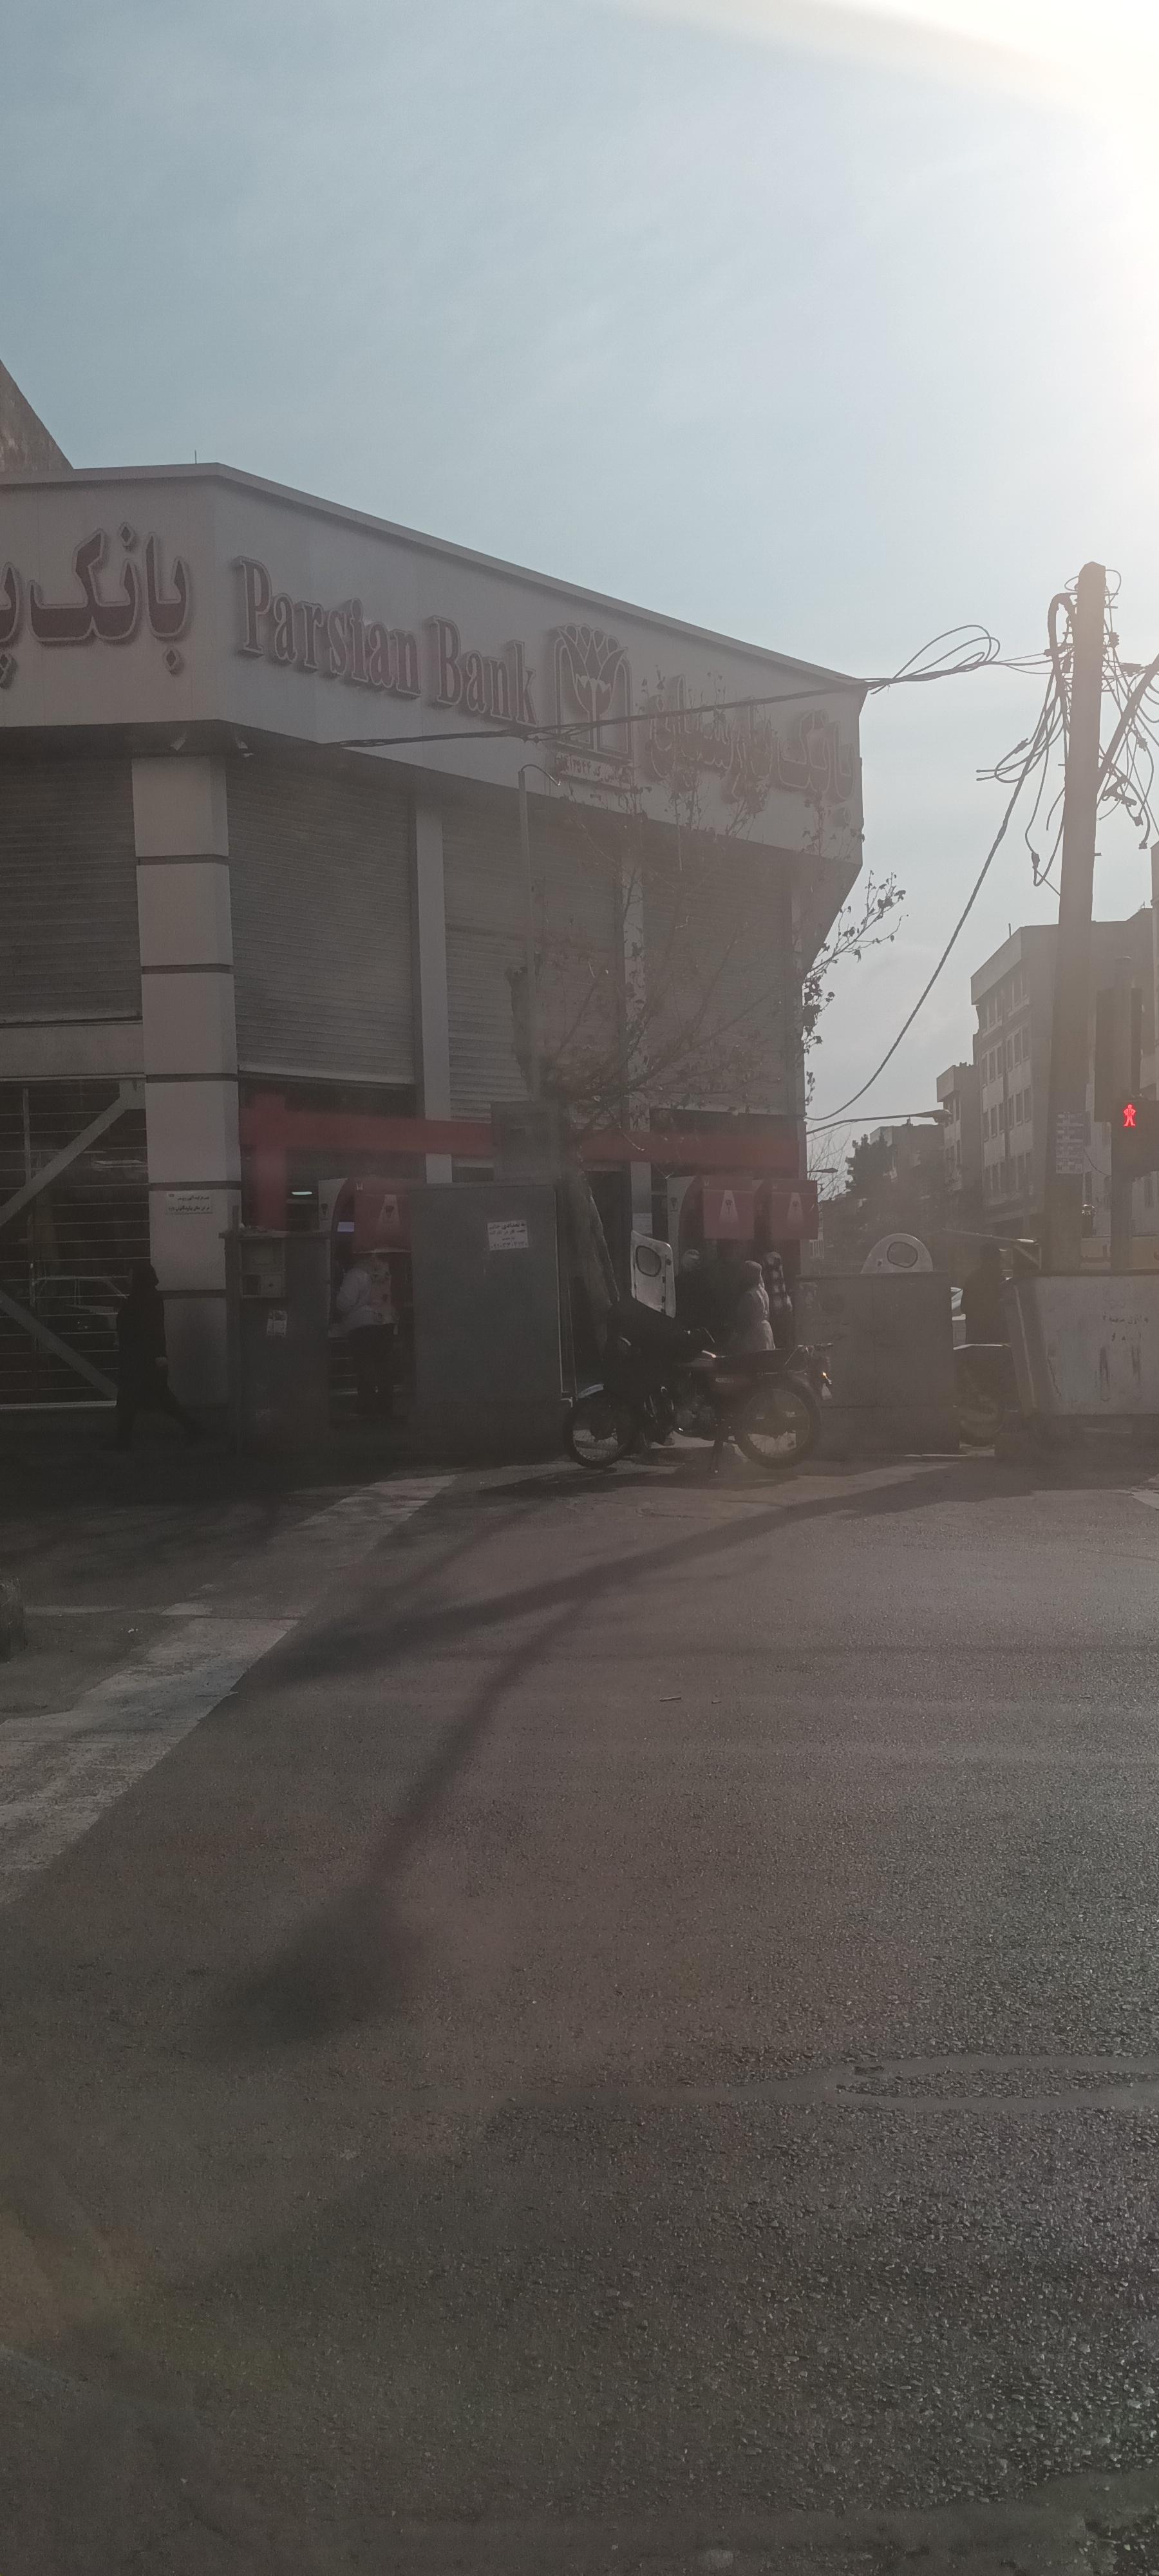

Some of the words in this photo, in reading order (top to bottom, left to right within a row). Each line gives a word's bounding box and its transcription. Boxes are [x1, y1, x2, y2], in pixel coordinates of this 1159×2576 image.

[26, 521, 191, 674] بانک
[233, 555, 422, 698] Parsian
[426, 614, 539, 728] Bank
[773, 708, 856, 826] بانک
